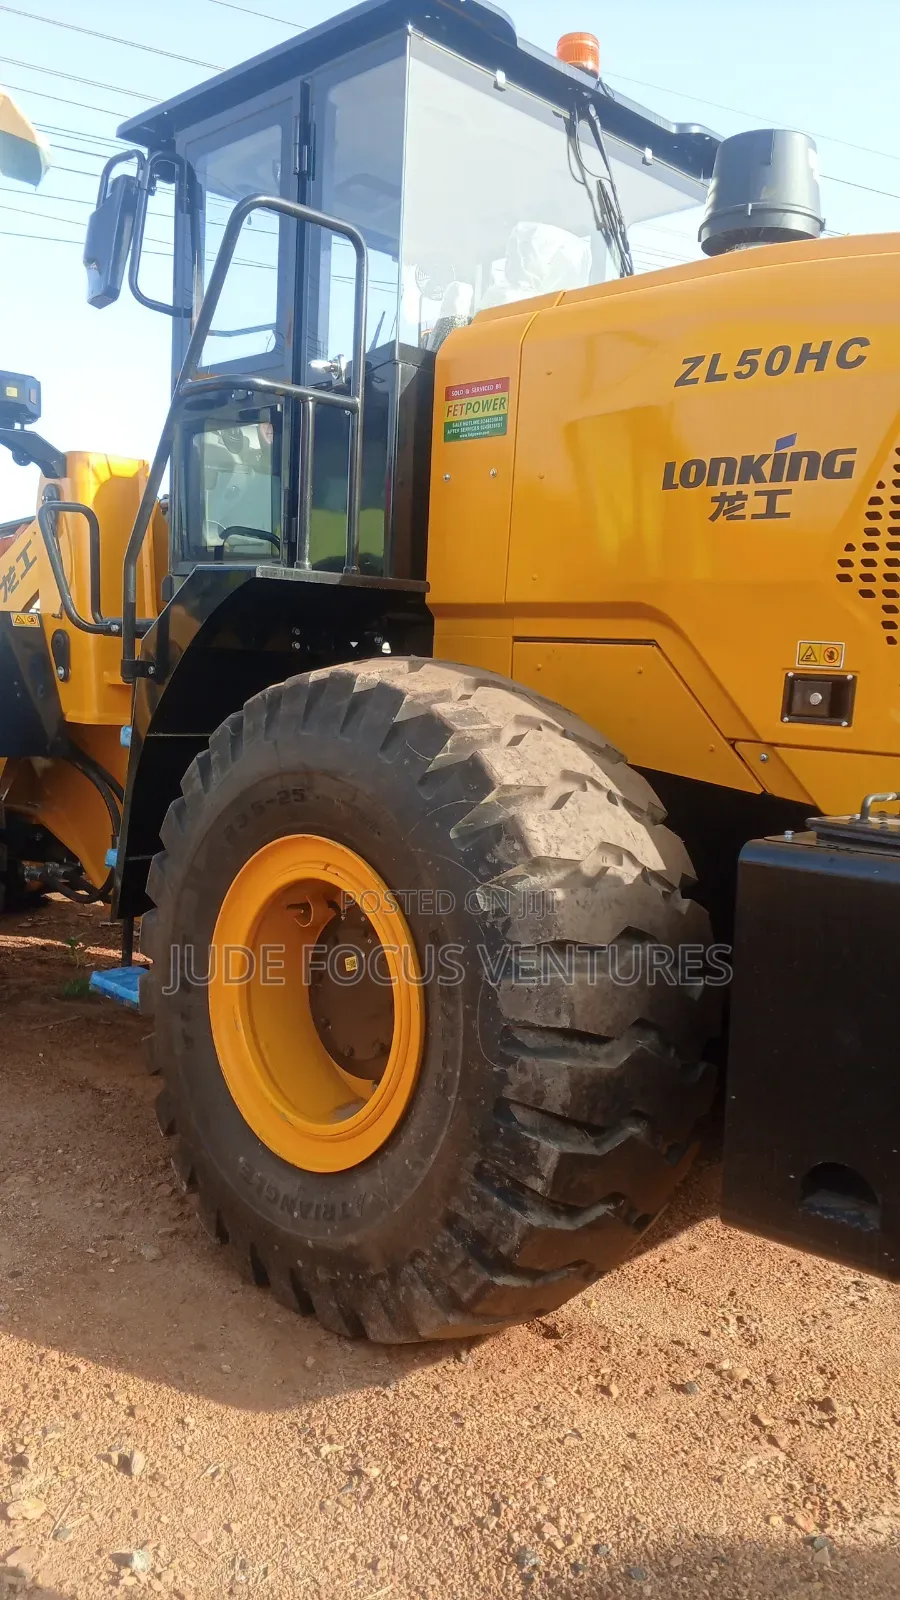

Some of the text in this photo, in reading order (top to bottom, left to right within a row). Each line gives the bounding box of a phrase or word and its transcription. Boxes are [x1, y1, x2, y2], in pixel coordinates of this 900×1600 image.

[673, 336, 871, 388] ZL50HC
[446, 396, 507, 418] FETPOWER
[451, 389, 464, 397] SOLD
[471, 384, 494, 394] SERVICED
[661, 432, 858, 490] LONKING
